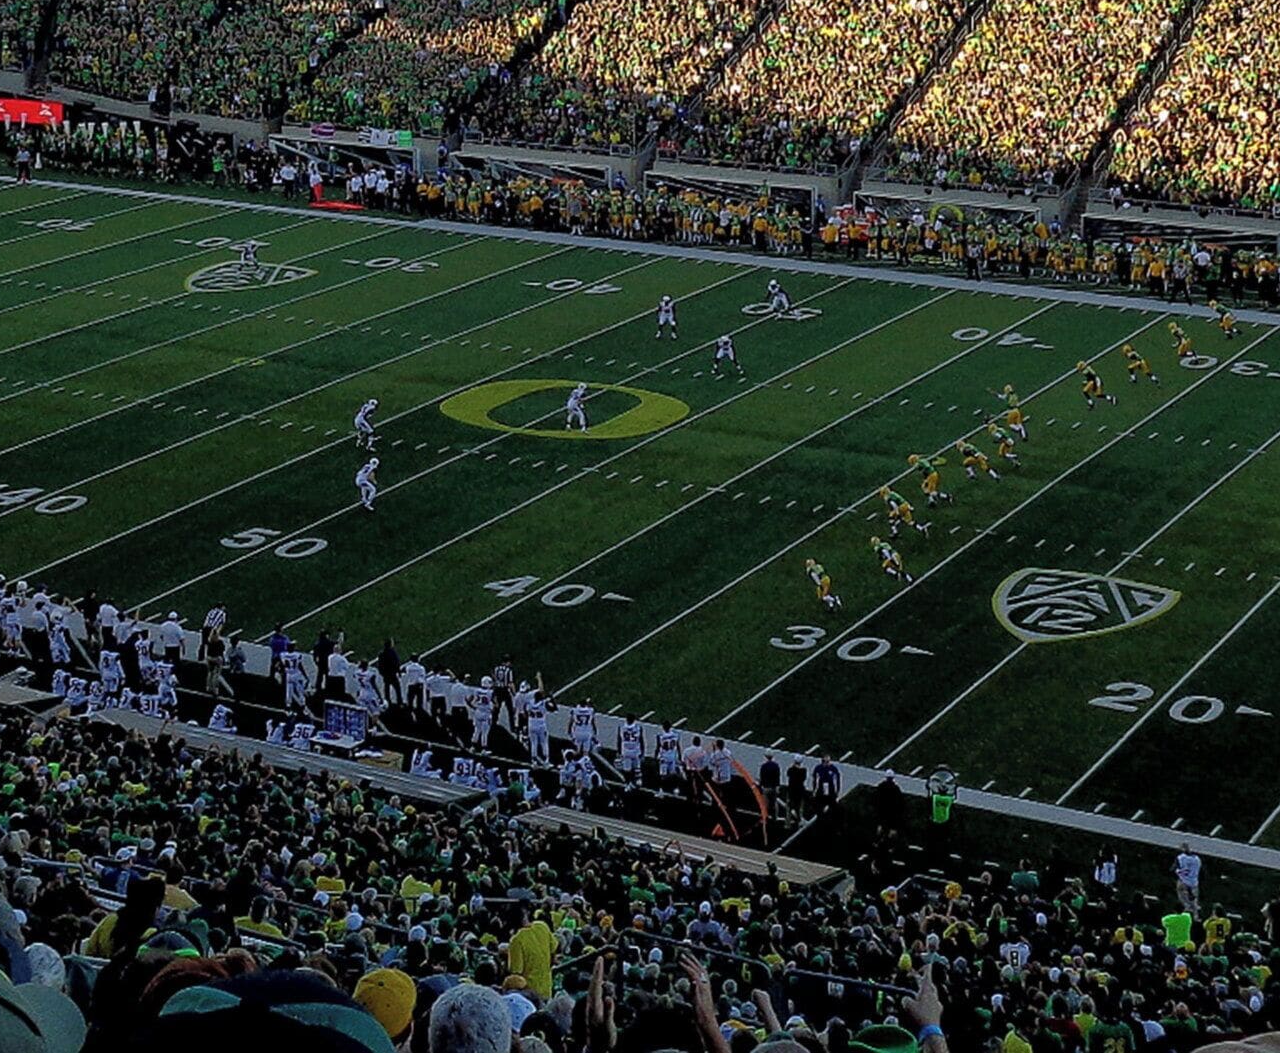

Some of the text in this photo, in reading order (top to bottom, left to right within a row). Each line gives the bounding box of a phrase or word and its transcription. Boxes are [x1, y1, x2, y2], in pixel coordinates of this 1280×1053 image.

[439, 379, 691, 440] O
[220, 527, 329, 559] 50
[482, 575, 596, 608] 40
[770, 624, 892, 663] 30
[1088, 681, 1226, 724] 20
